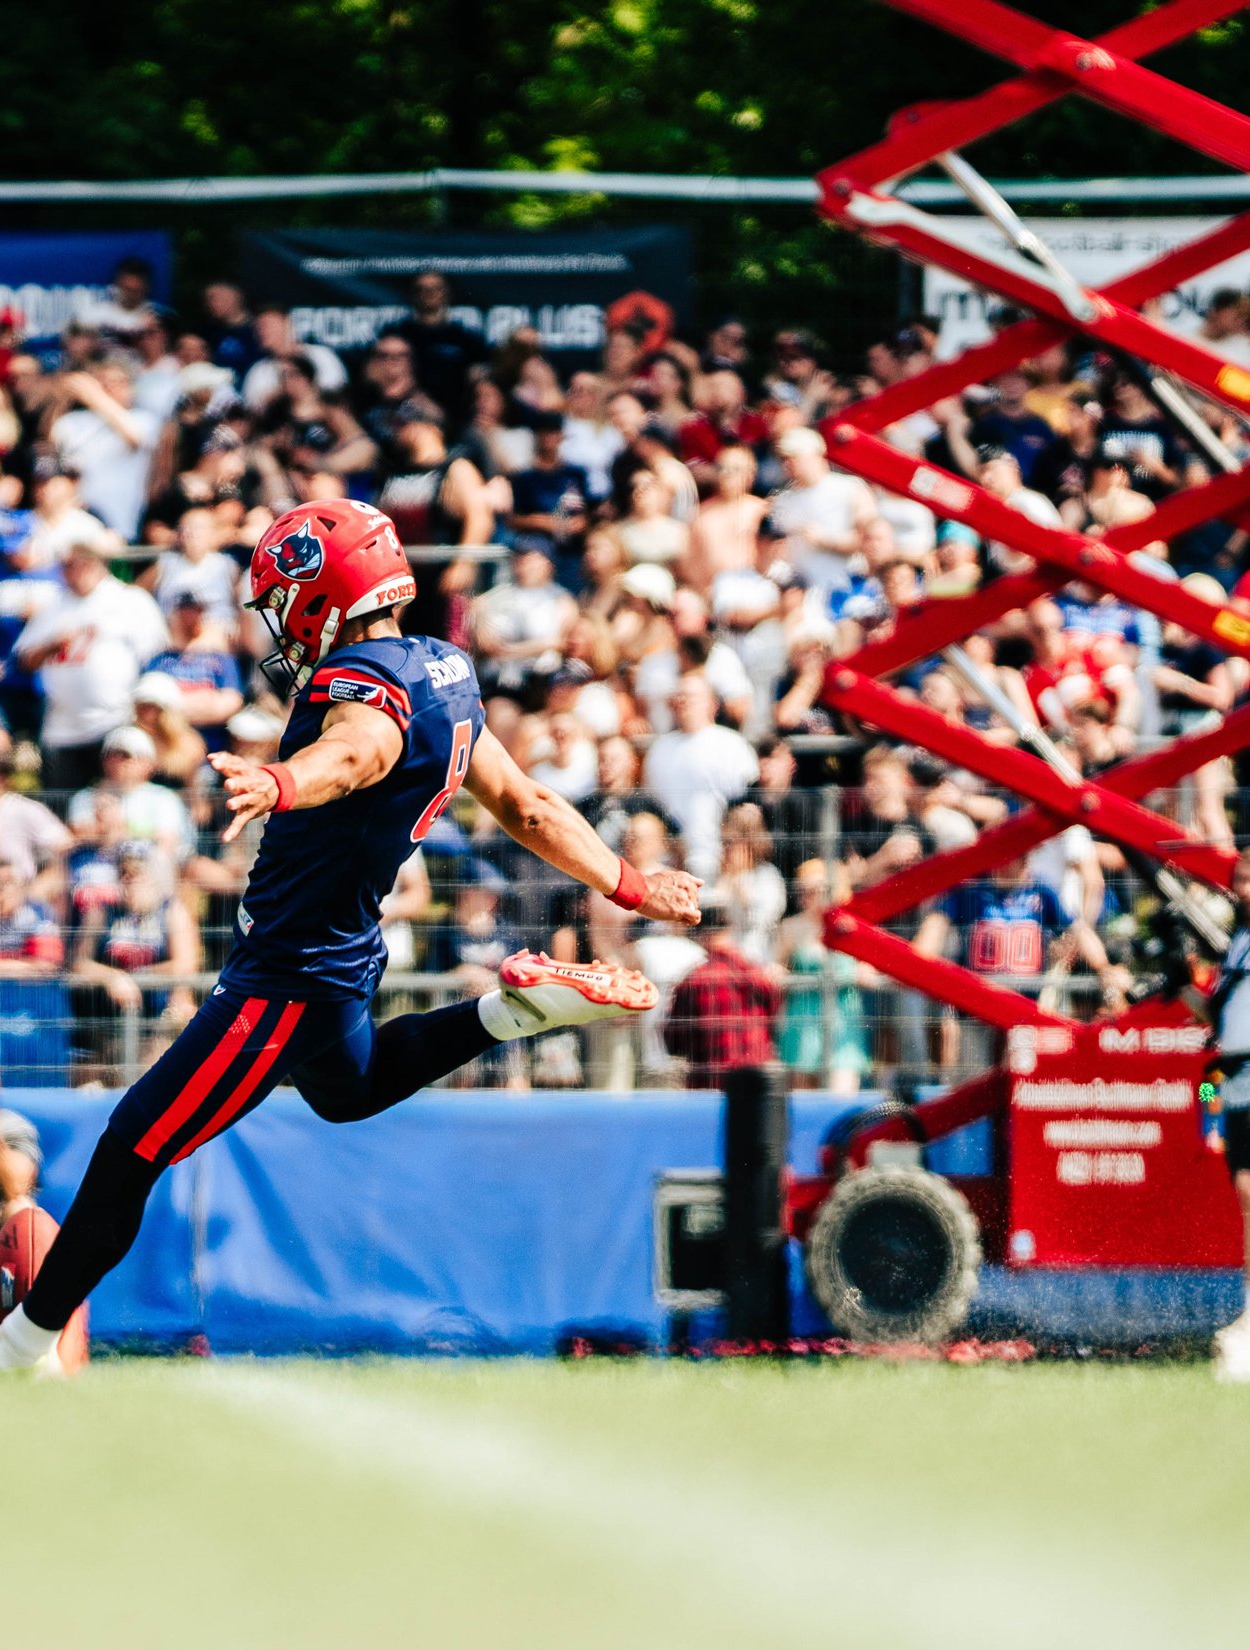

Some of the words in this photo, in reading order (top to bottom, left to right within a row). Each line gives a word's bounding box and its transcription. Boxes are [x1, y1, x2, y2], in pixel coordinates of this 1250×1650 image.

[332, 686, 350, 694] LEAGUE
[333, 681, 359, 691] EUROPEAN
[331, 691, 355, 700] FOOTBALL
[410, 718, 472, 843] 8
[555, 967, 603, 981] TIEMPO
